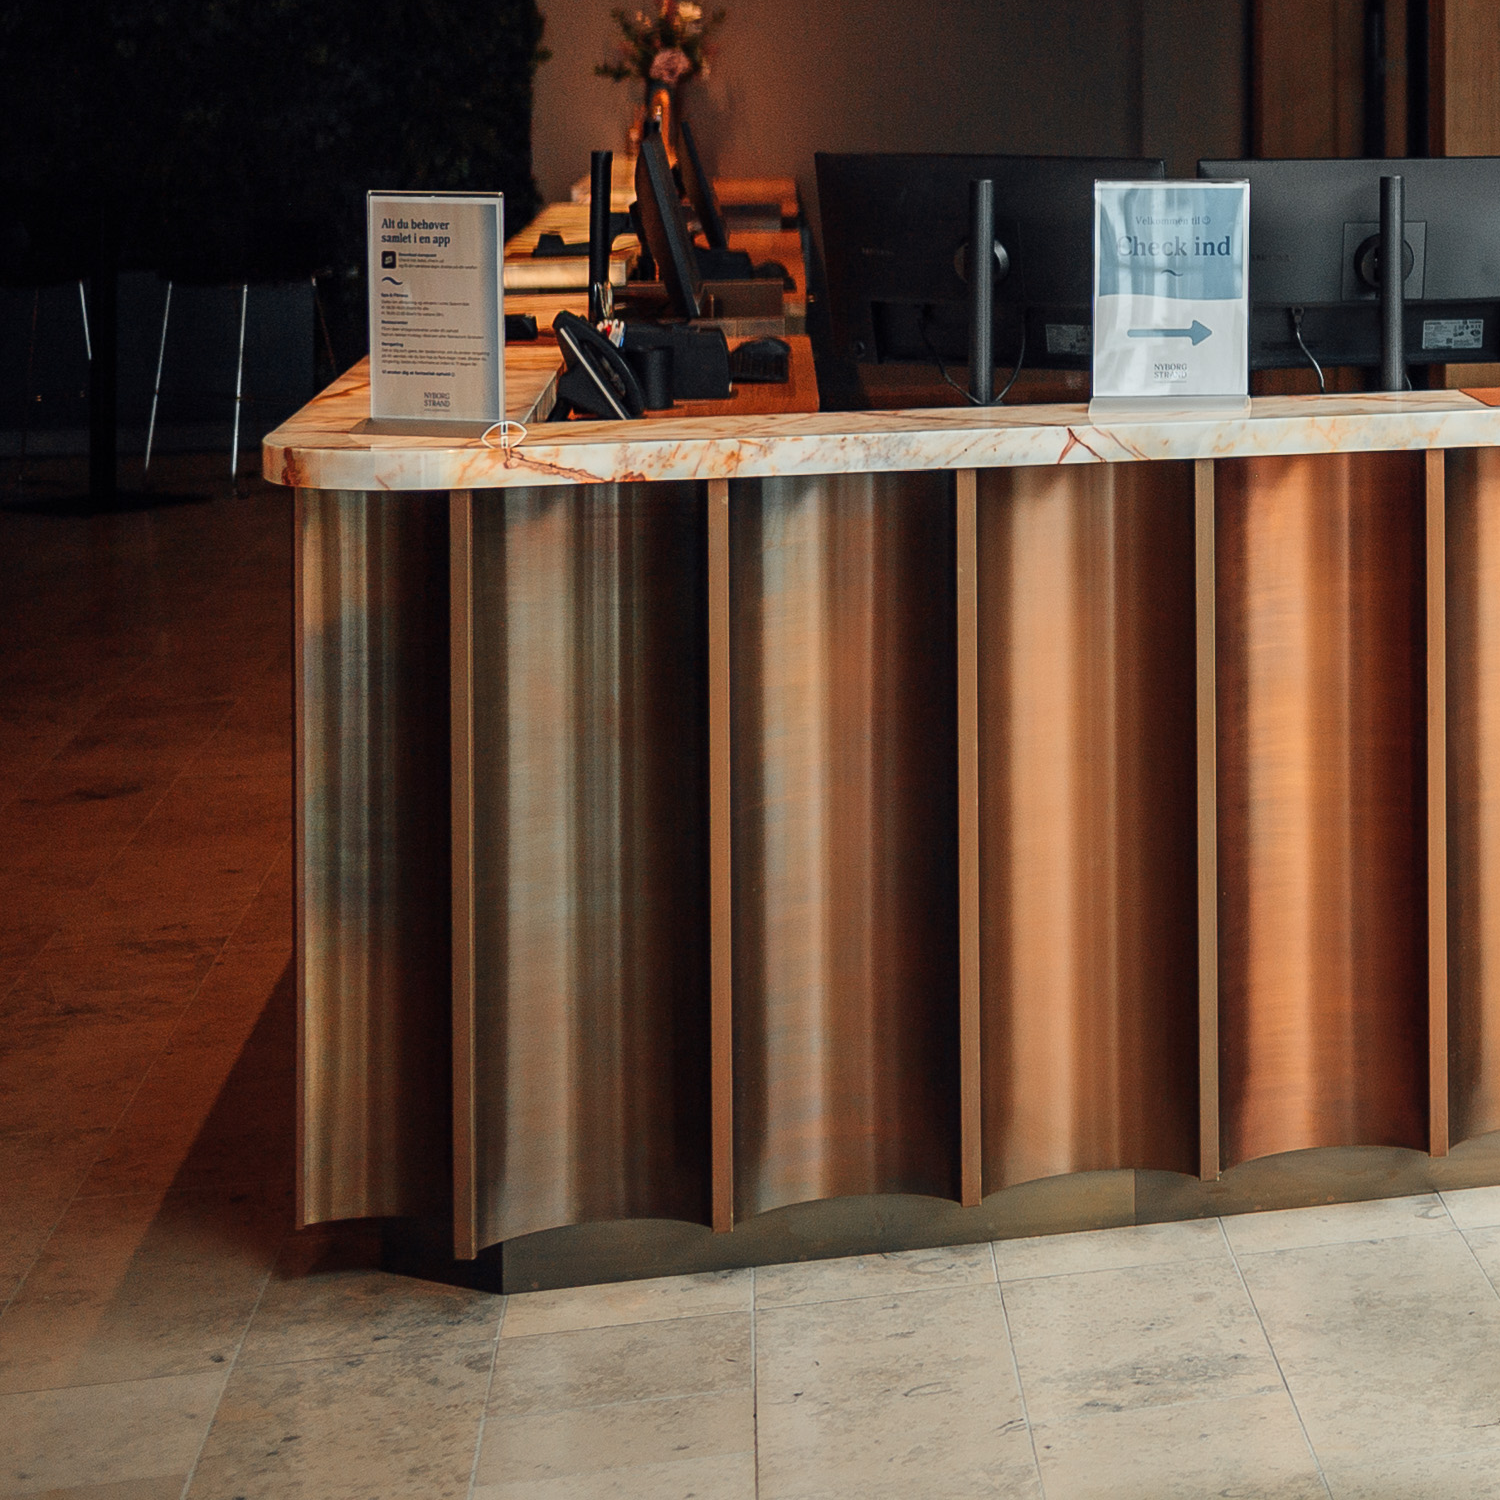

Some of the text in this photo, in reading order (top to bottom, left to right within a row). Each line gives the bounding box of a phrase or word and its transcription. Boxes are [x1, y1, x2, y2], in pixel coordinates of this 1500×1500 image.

[381, 218, 395, 229] Alt
[397, 218, 409, 229] du
[1191, 215, 1200, 225] til
[381, 232, 411, 243] samlet
[419, 235, 431, 244] en
[432, 235, 451, 248] app
[1117, 235, 1231, 257] Check ind
[1154, 363, 1188, 371] NYBORG
[423, 391, 450, 399] NYBORG
